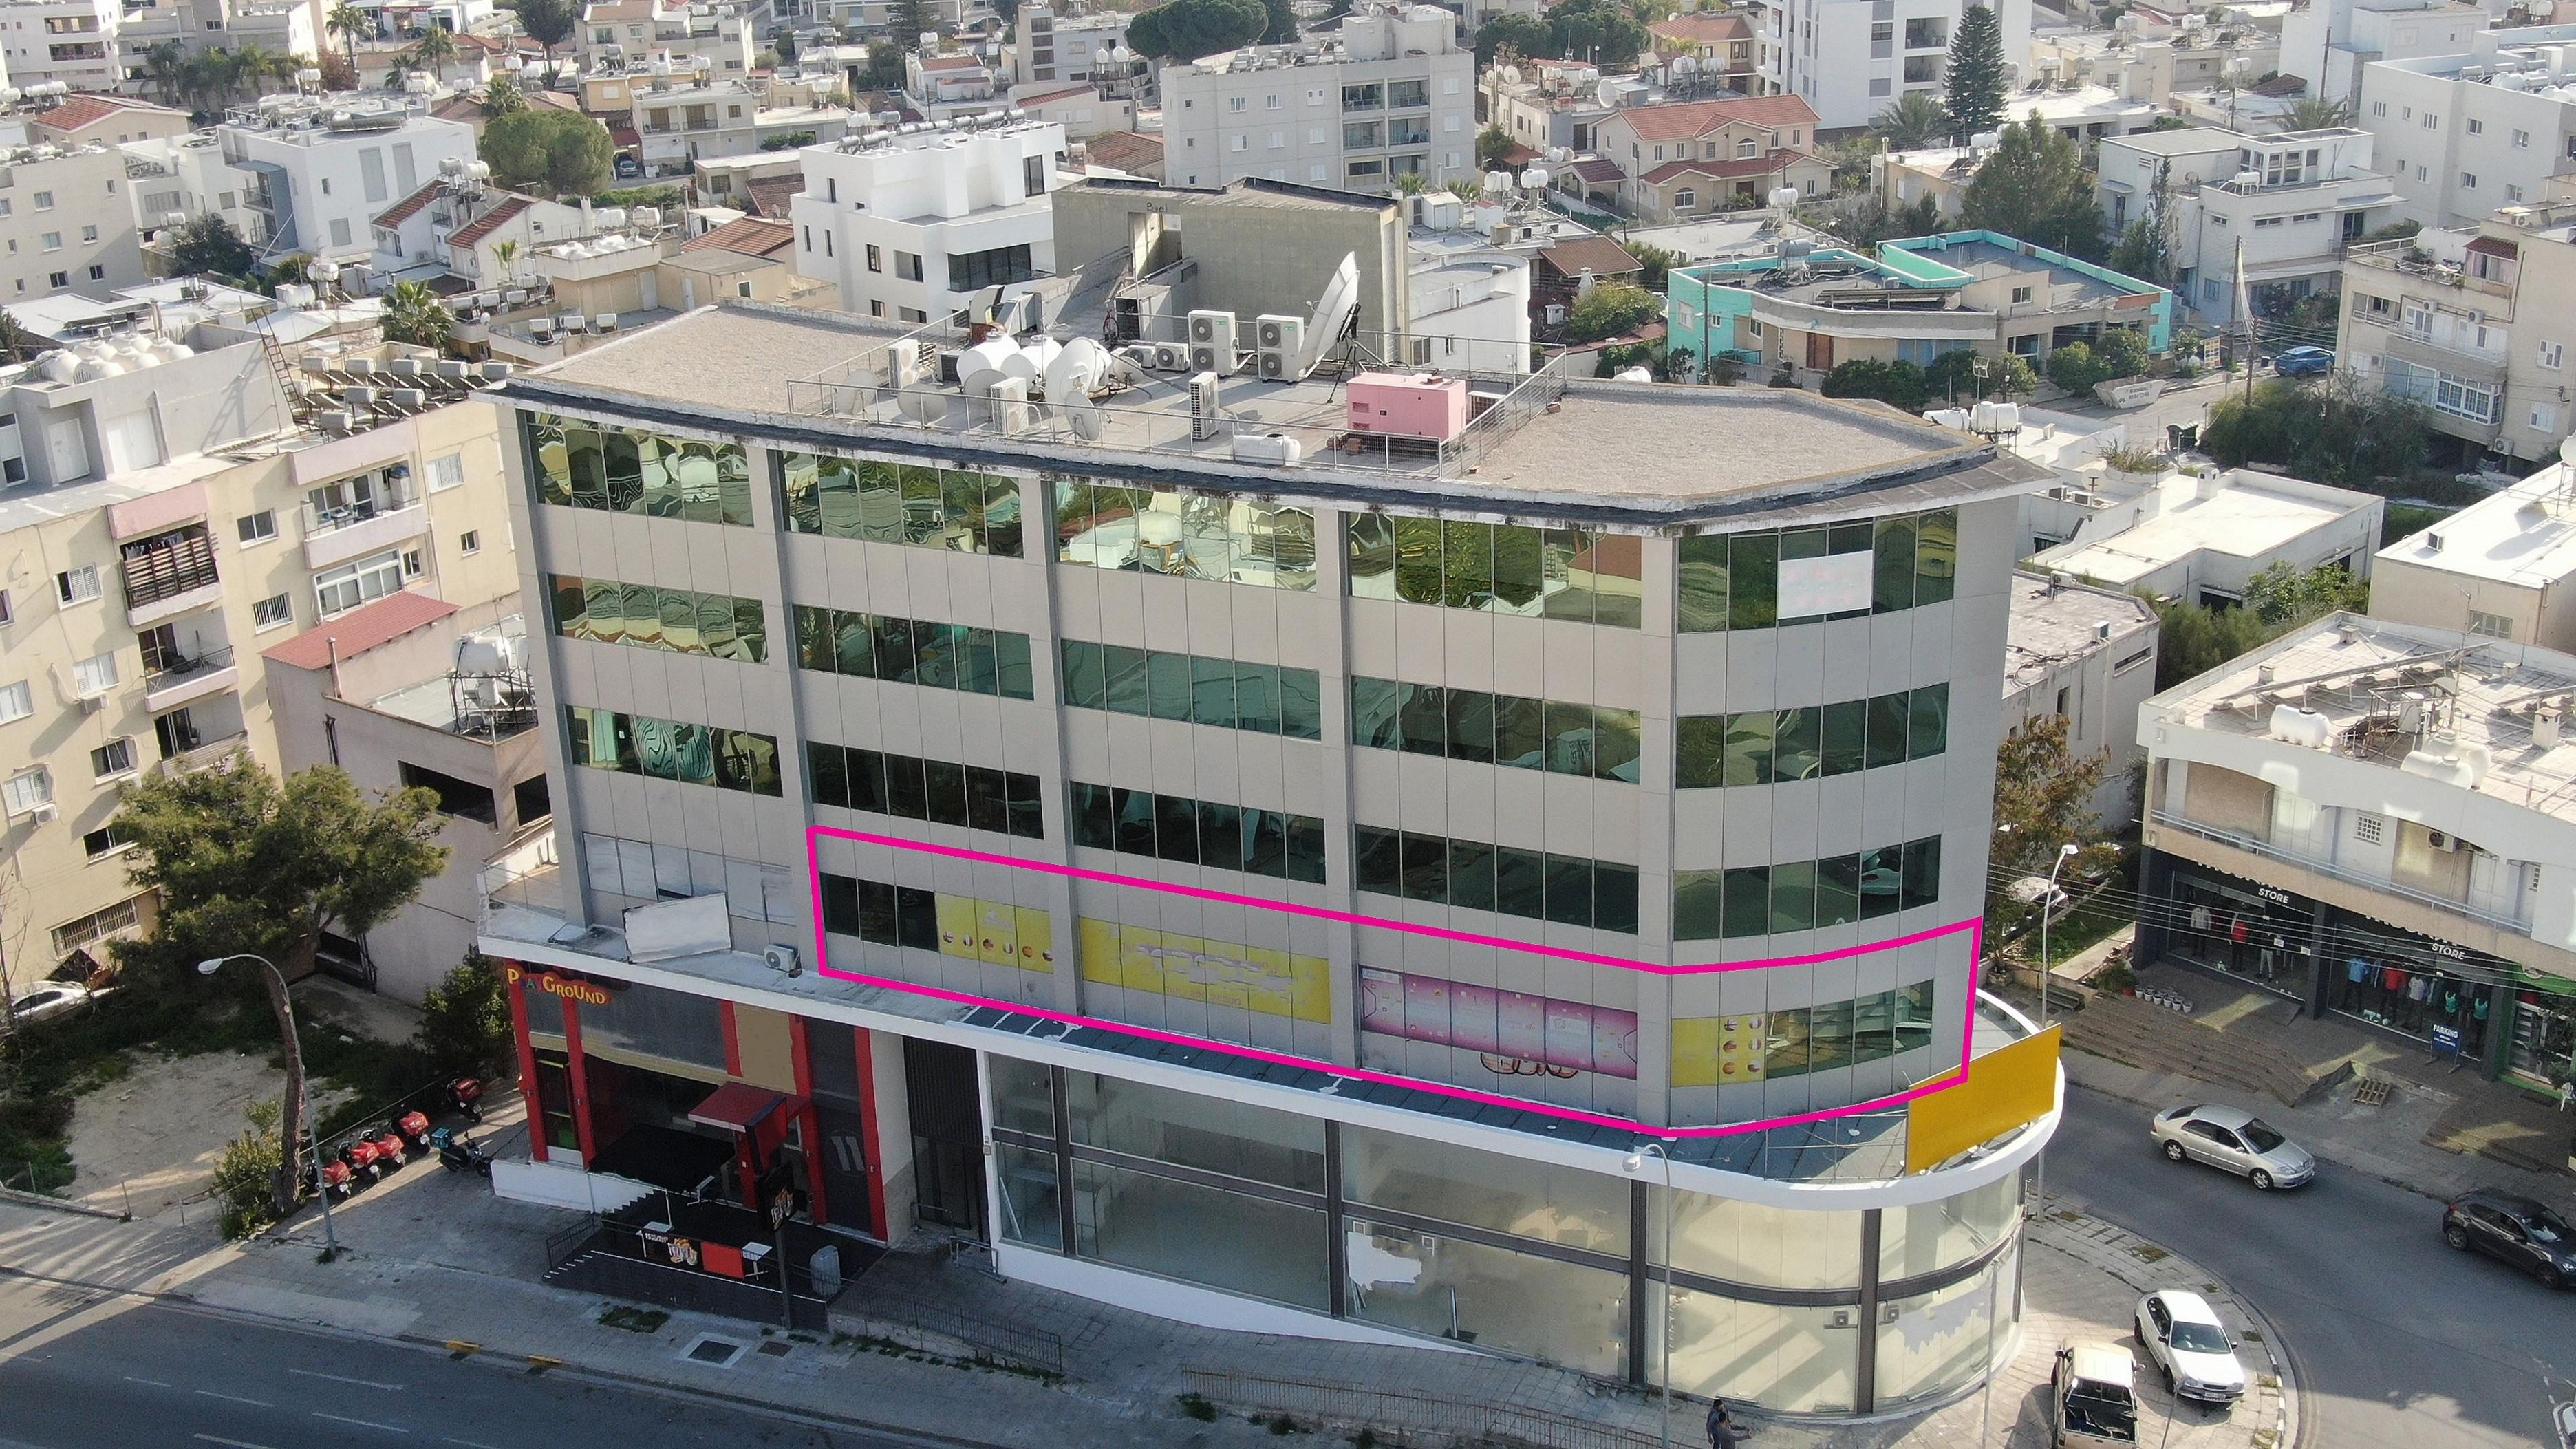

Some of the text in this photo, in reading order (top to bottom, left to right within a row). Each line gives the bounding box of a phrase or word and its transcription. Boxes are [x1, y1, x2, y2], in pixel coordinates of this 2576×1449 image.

[2258, 888, 2289, 903] STORE
[2432, 943, 2465, 960] STORE
[507, 968, 605, 1004] PAGROUND
